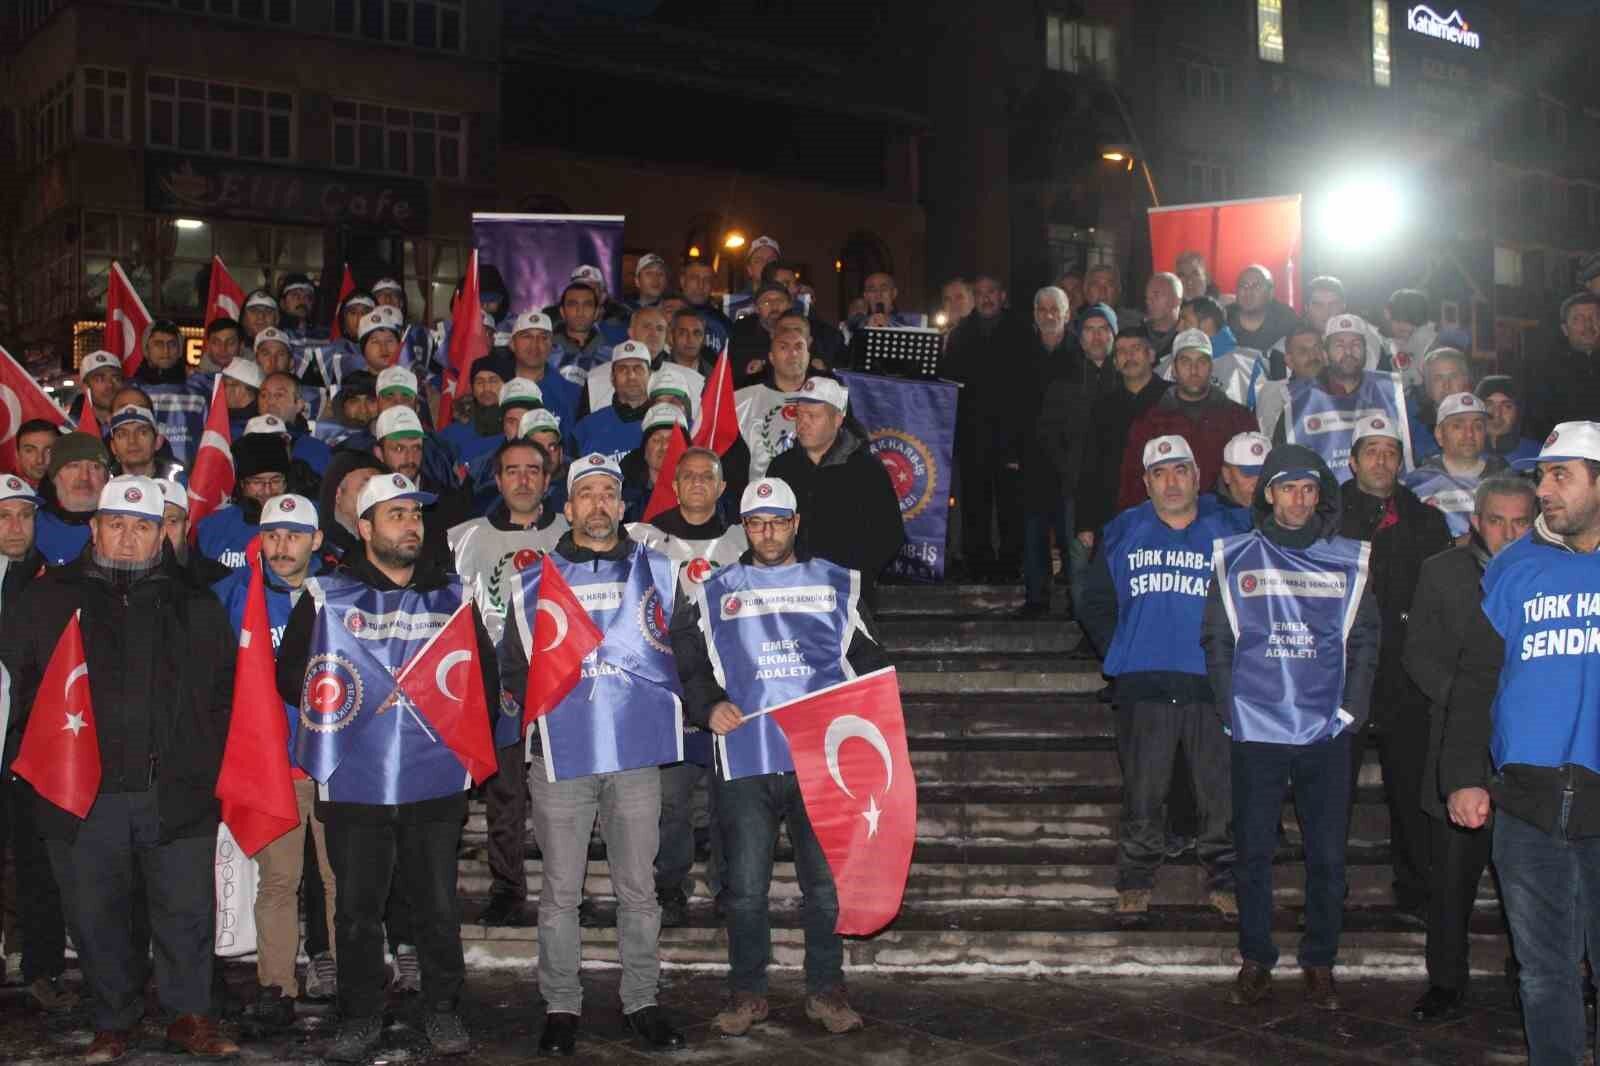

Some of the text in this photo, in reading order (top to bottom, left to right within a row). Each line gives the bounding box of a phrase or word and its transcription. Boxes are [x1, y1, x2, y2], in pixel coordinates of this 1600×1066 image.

[321, 184, 410, 219] Cafe
[1128, 549, 1162, 570] TÜRK
[1523, 592, 1571, 624] TÜRK
[1272, 622, 1308, 632] EMEK
[762, 640, 799, 652] EMEK
[1269, 634, 1314, 645] EKMEK
[758, 653, 805, 666] EKMEK
